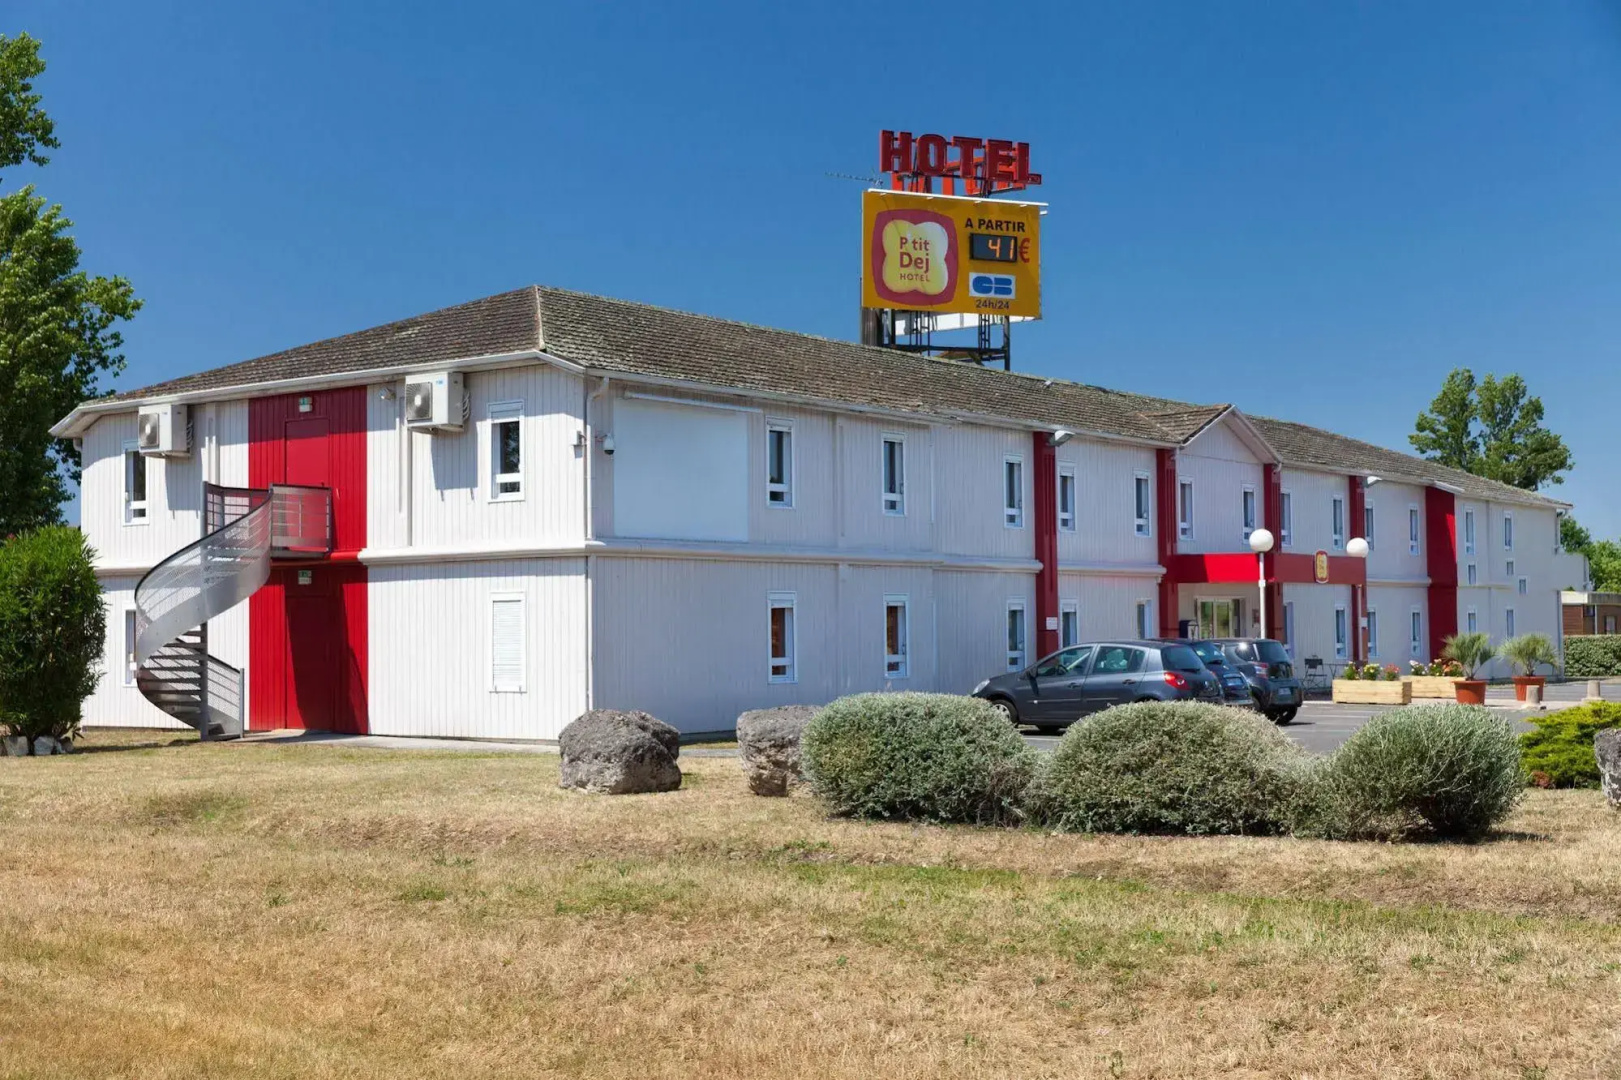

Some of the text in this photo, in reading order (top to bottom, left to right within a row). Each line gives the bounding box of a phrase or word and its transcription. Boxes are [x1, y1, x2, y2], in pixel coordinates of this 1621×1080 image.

[880, 130, 1041, 185] HOTEL
[965, 217, 1025, 233] A PARTIR
[988, 238, 1015, 260] 41
[900, 252, 930, 273] Dej
[900, 273, 930, 282] HOTEL
[976, 299, 1010, 309] 24h/24
